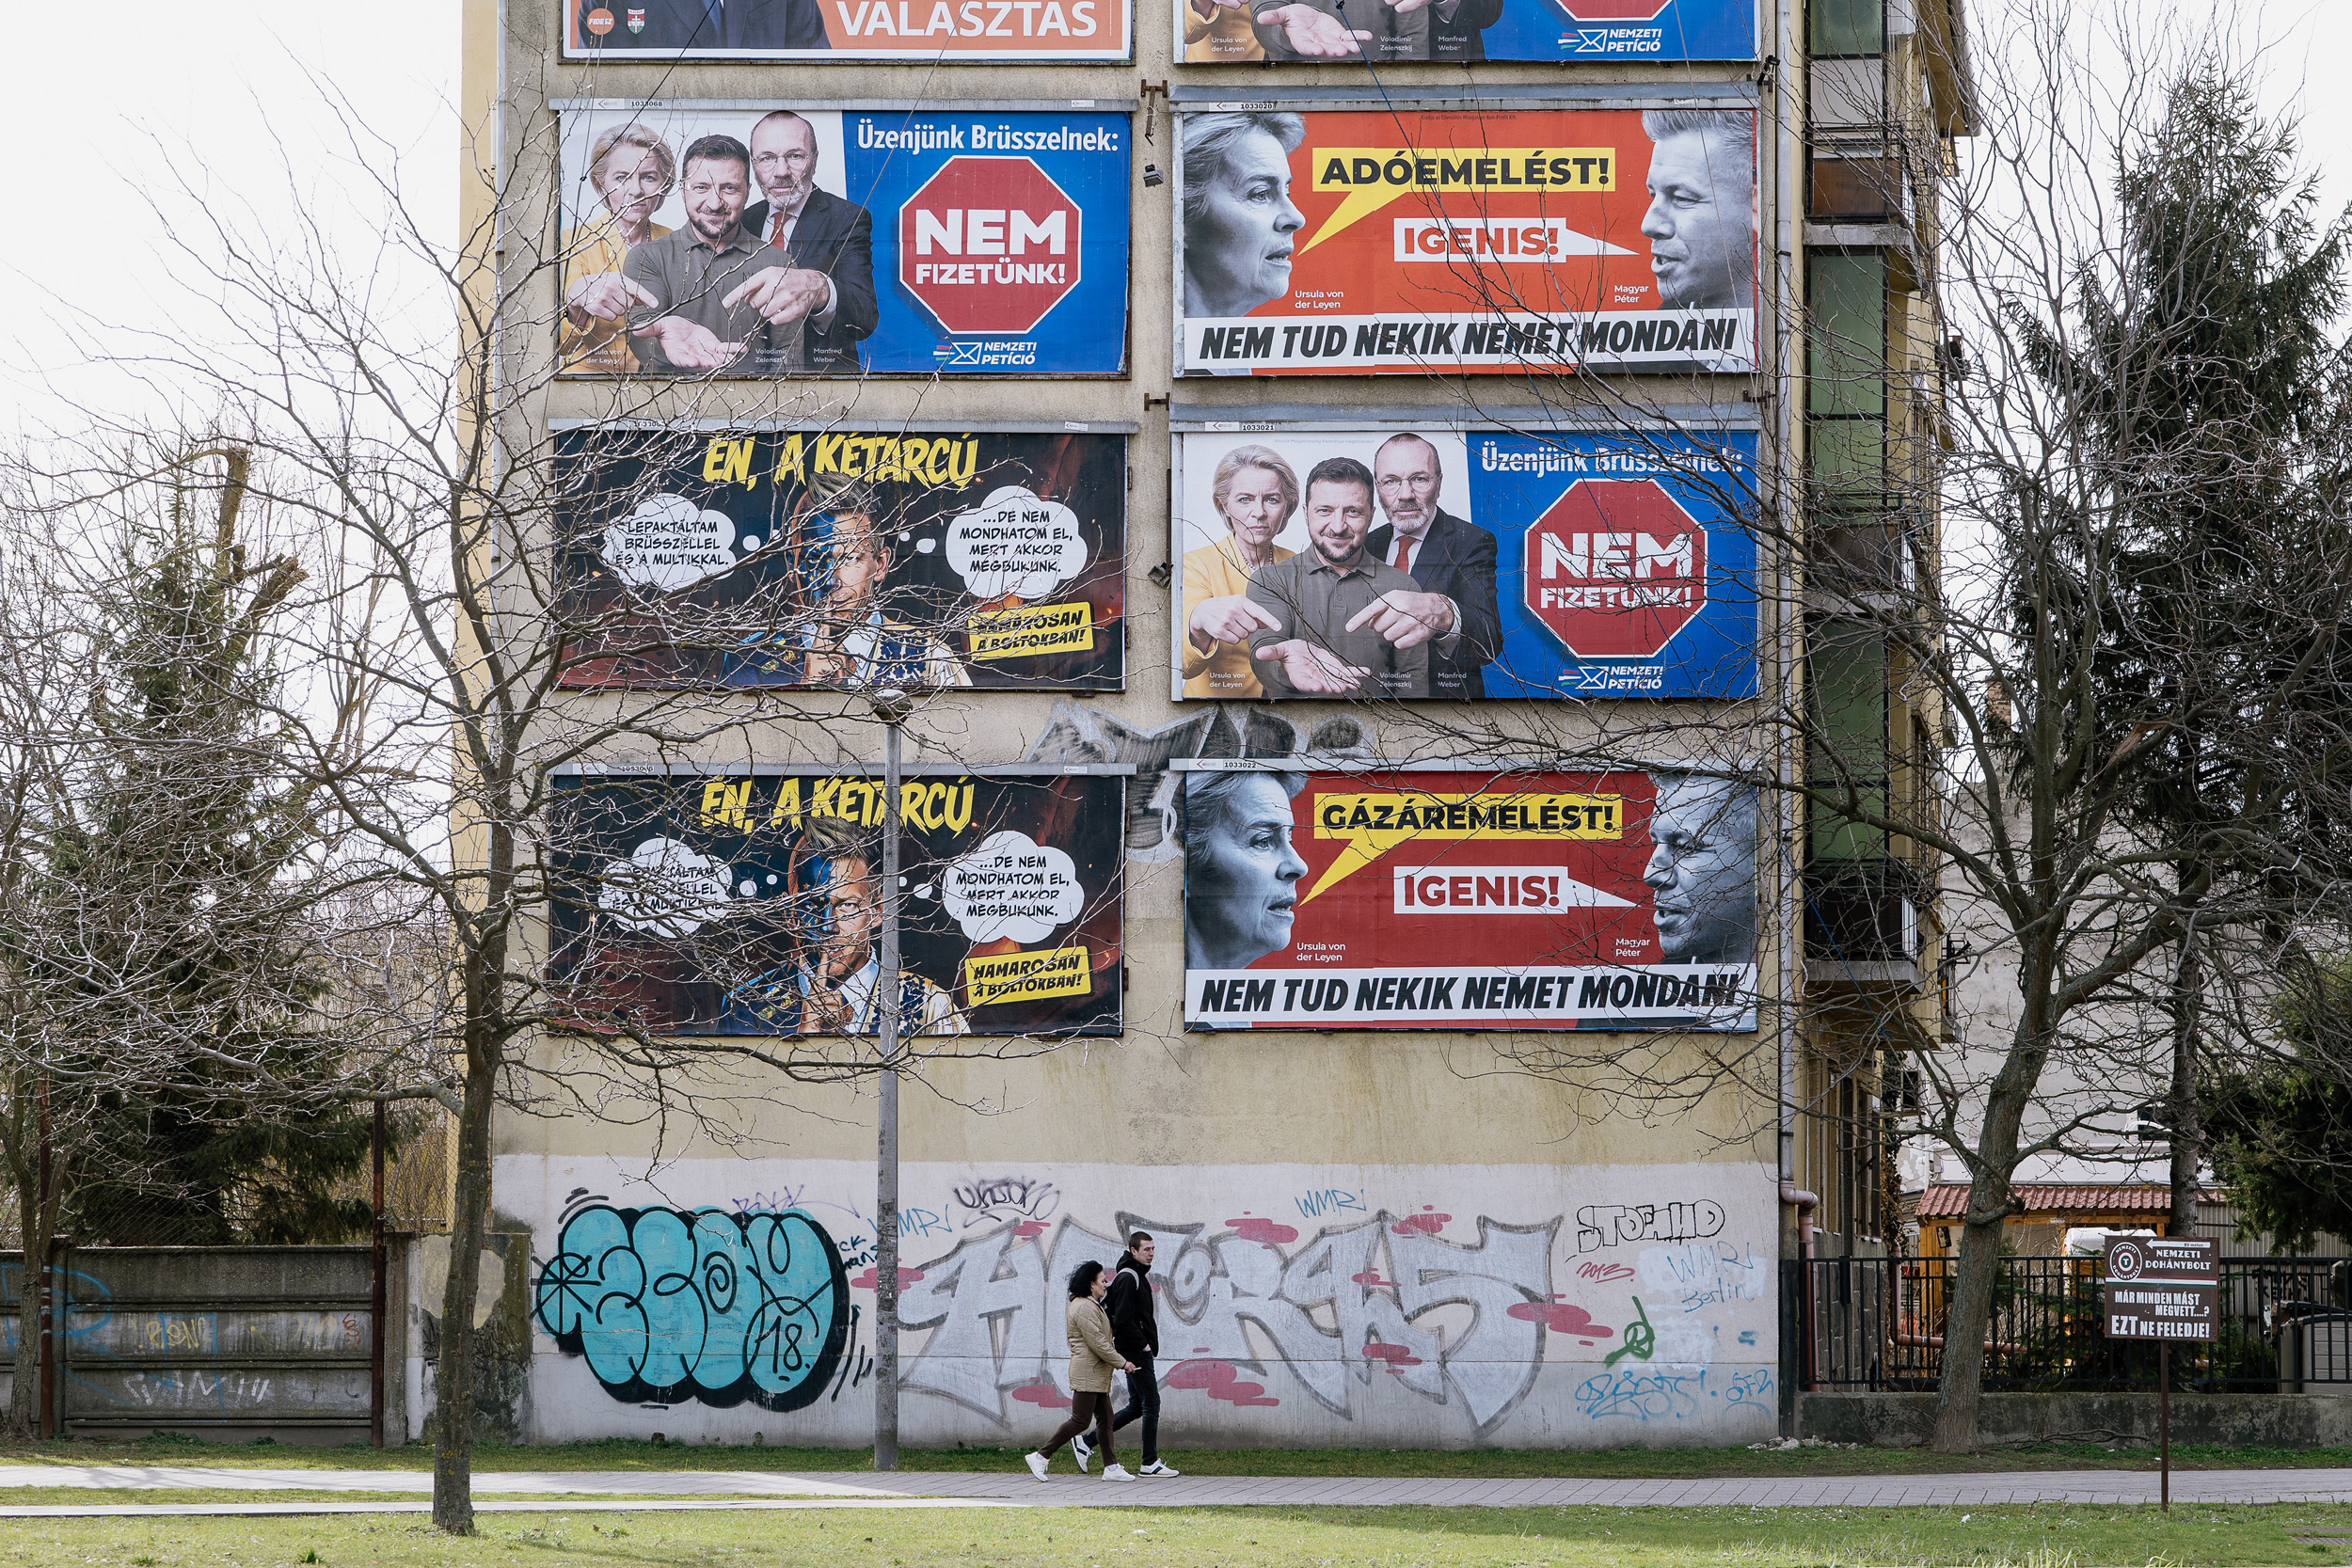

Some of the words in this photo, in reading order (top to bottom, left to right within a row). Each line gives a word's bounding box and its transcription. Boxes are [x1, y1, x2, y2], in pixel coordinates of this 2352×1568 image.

[1610, 29, 1662, 39] NEMZETI
[1607, 39, 1661, 53] PETÍCIÓ
[858, 119, 964, 155] Üzenjünk
[971, 124, 1119, 151] Brüsszelnek:
[1321, 150, 1610, 185] ADÓEMELÉST!
[915, 209, 1067, 255] NEM
[1405, 227, 1559, 255] IGENIS!
[915, 257, 1066, 284] FIZETÜNK!
[1295, 290, 1325, 298] Ursula
[1613, 285, 1649, 294] Magyar
[1295, 300, 1311, 309] der
[1313, 300, 1341, 309] Leyen
[1613, 294, 1640, 303] Péter
[1200, 327, 1275, 359] NEM
[1282, 325, 1347, 358] TUD
[1353, 323, 1459, 356] NEKIK
[1462, 322, 1575, 355] NEMET
[1580, 318, 1738, 353] MONDANI
[984, 341, 1037, 352] NEMZETI
[981, 352, 1036, 365] PETÍCIÓ
[773, 433, 807, 486] A
[814, 432, 979, 494] KÉTARCÚ
[1482, 441, 1587, 478] Üzenjünk
[1022, 510, 1051, 523] NEM
[960, 527, 1047, 540] MONDHATOM
[1053, 528, 1073, 542] EL,
[1541, 532, 1692, 578] NEM
[1610, 665, 1664, 675] NEMZETI
[1608, 676, 1662, 689] PETÍCIÓ
[770, 777, 803, 832] A
[1322, 798, 1614, 831] GÁZÁREMELÉST!
[979, 856, 1013, 868] ...DE
[1019, 855, 1047, 868] NEM
[956, 872, 1044, 885] MONDHATOM
[1050, 873, 1070, 887] EL,
[966, 889, 1006, 900] MERT
[1011, 889, 1060, 900] AKKOR
[1405, 875, 1560, 907] IGENIS!
[966, 904, 1058, 917] MEGBUKUNK.
[1296, 942, 1327, 951] Ursula
[1615, 946, 1641, 957] Péter
[1296, 953, 1312, 961] der
[1314, 953, 1343, 962] Leyen
[973, 954, 1081, 980] HAMAROSAN
[1201, 979, 1277, 1012] NEM
[1283, 978, 1349, 1012] TUD
[1354, 976, 1459, 1010] NEKIK
[1461, 975, 1575, 1009] NEMET
[1578, 974, 1740, 1008] MONDANI
[2115, 1244, 2137, 1254] NEMZETI
[2155, 1249, 2201, 1259] NEMZETI
[2122, 1258, 2130, 1266] T
[2145, 1259, 2211, 1271] DOHÁNYBOLT
[1680, 1276, 1756, 1313] Berlin
[2114, 1290, 2136, 1304] MÁR
[2136, 1291, 2172, 1305] MINDEN
[2173, 1291, 2201, 1306] MÁST
[2111, 1314, 2138, 1336] EZT
[2139, 1321, 2155, 1337] NE
[2156, 1322, 2210, 1338] FELEDJE!
